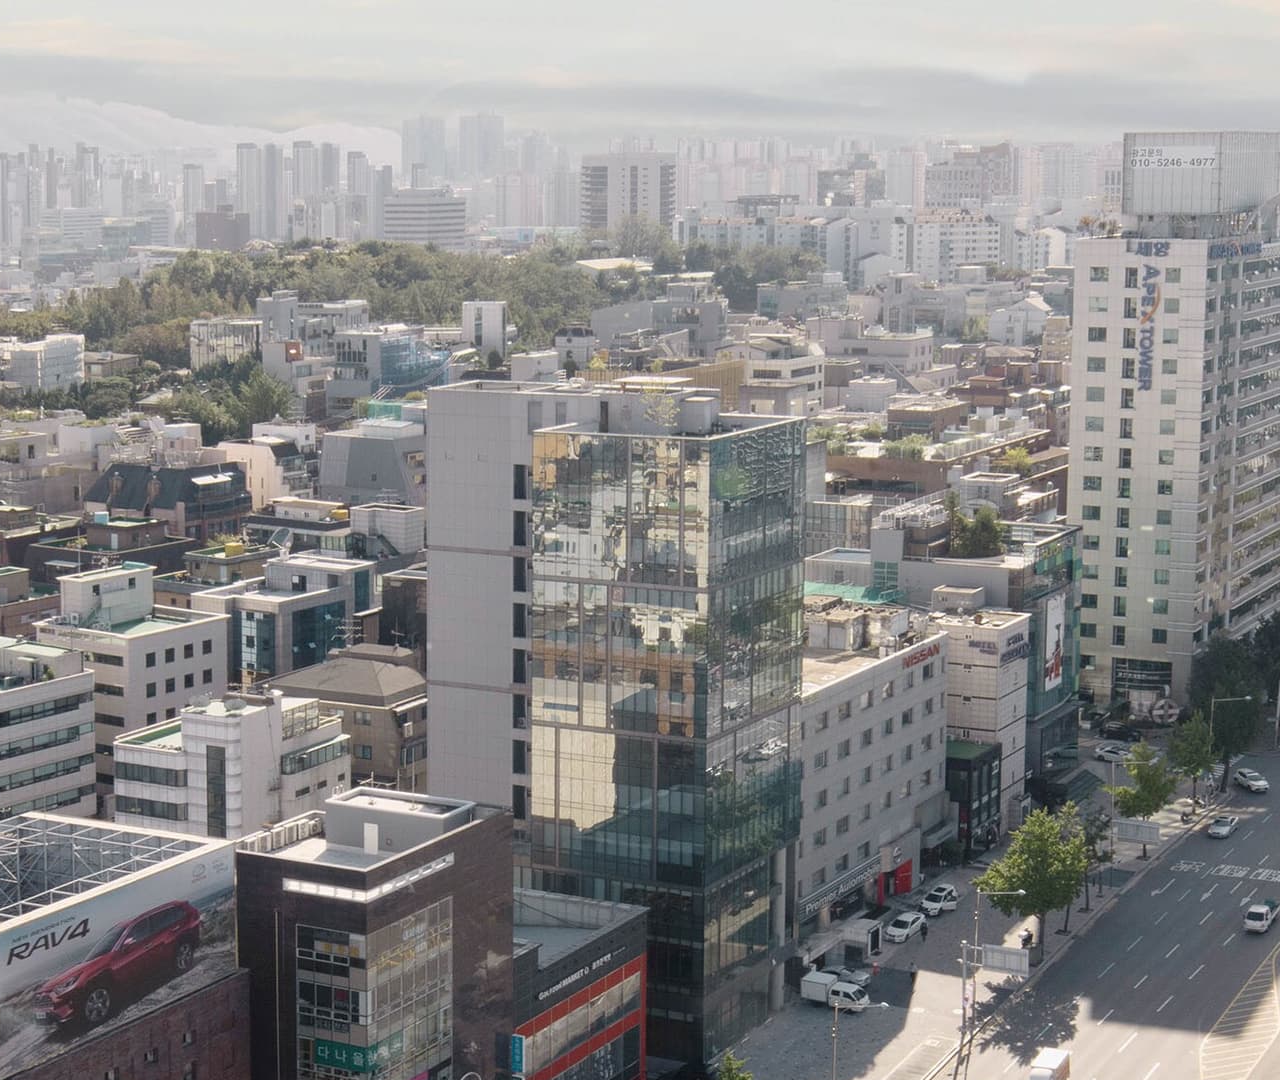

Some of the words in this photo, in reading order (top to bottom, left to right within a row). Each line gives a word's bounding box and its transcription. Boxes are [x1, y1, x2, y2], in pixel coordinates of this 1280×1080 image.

[1130, 158, 1216, 168] 010-5246-4977
[1131, 148, 1163, 158] 광고문의
[1137, 326, 1155, 392] TOWER
[903, 643, 940, 669] NISSAN
[805, 891, 838, 915] Premier
[6, 918, 90, 966] RAV4
